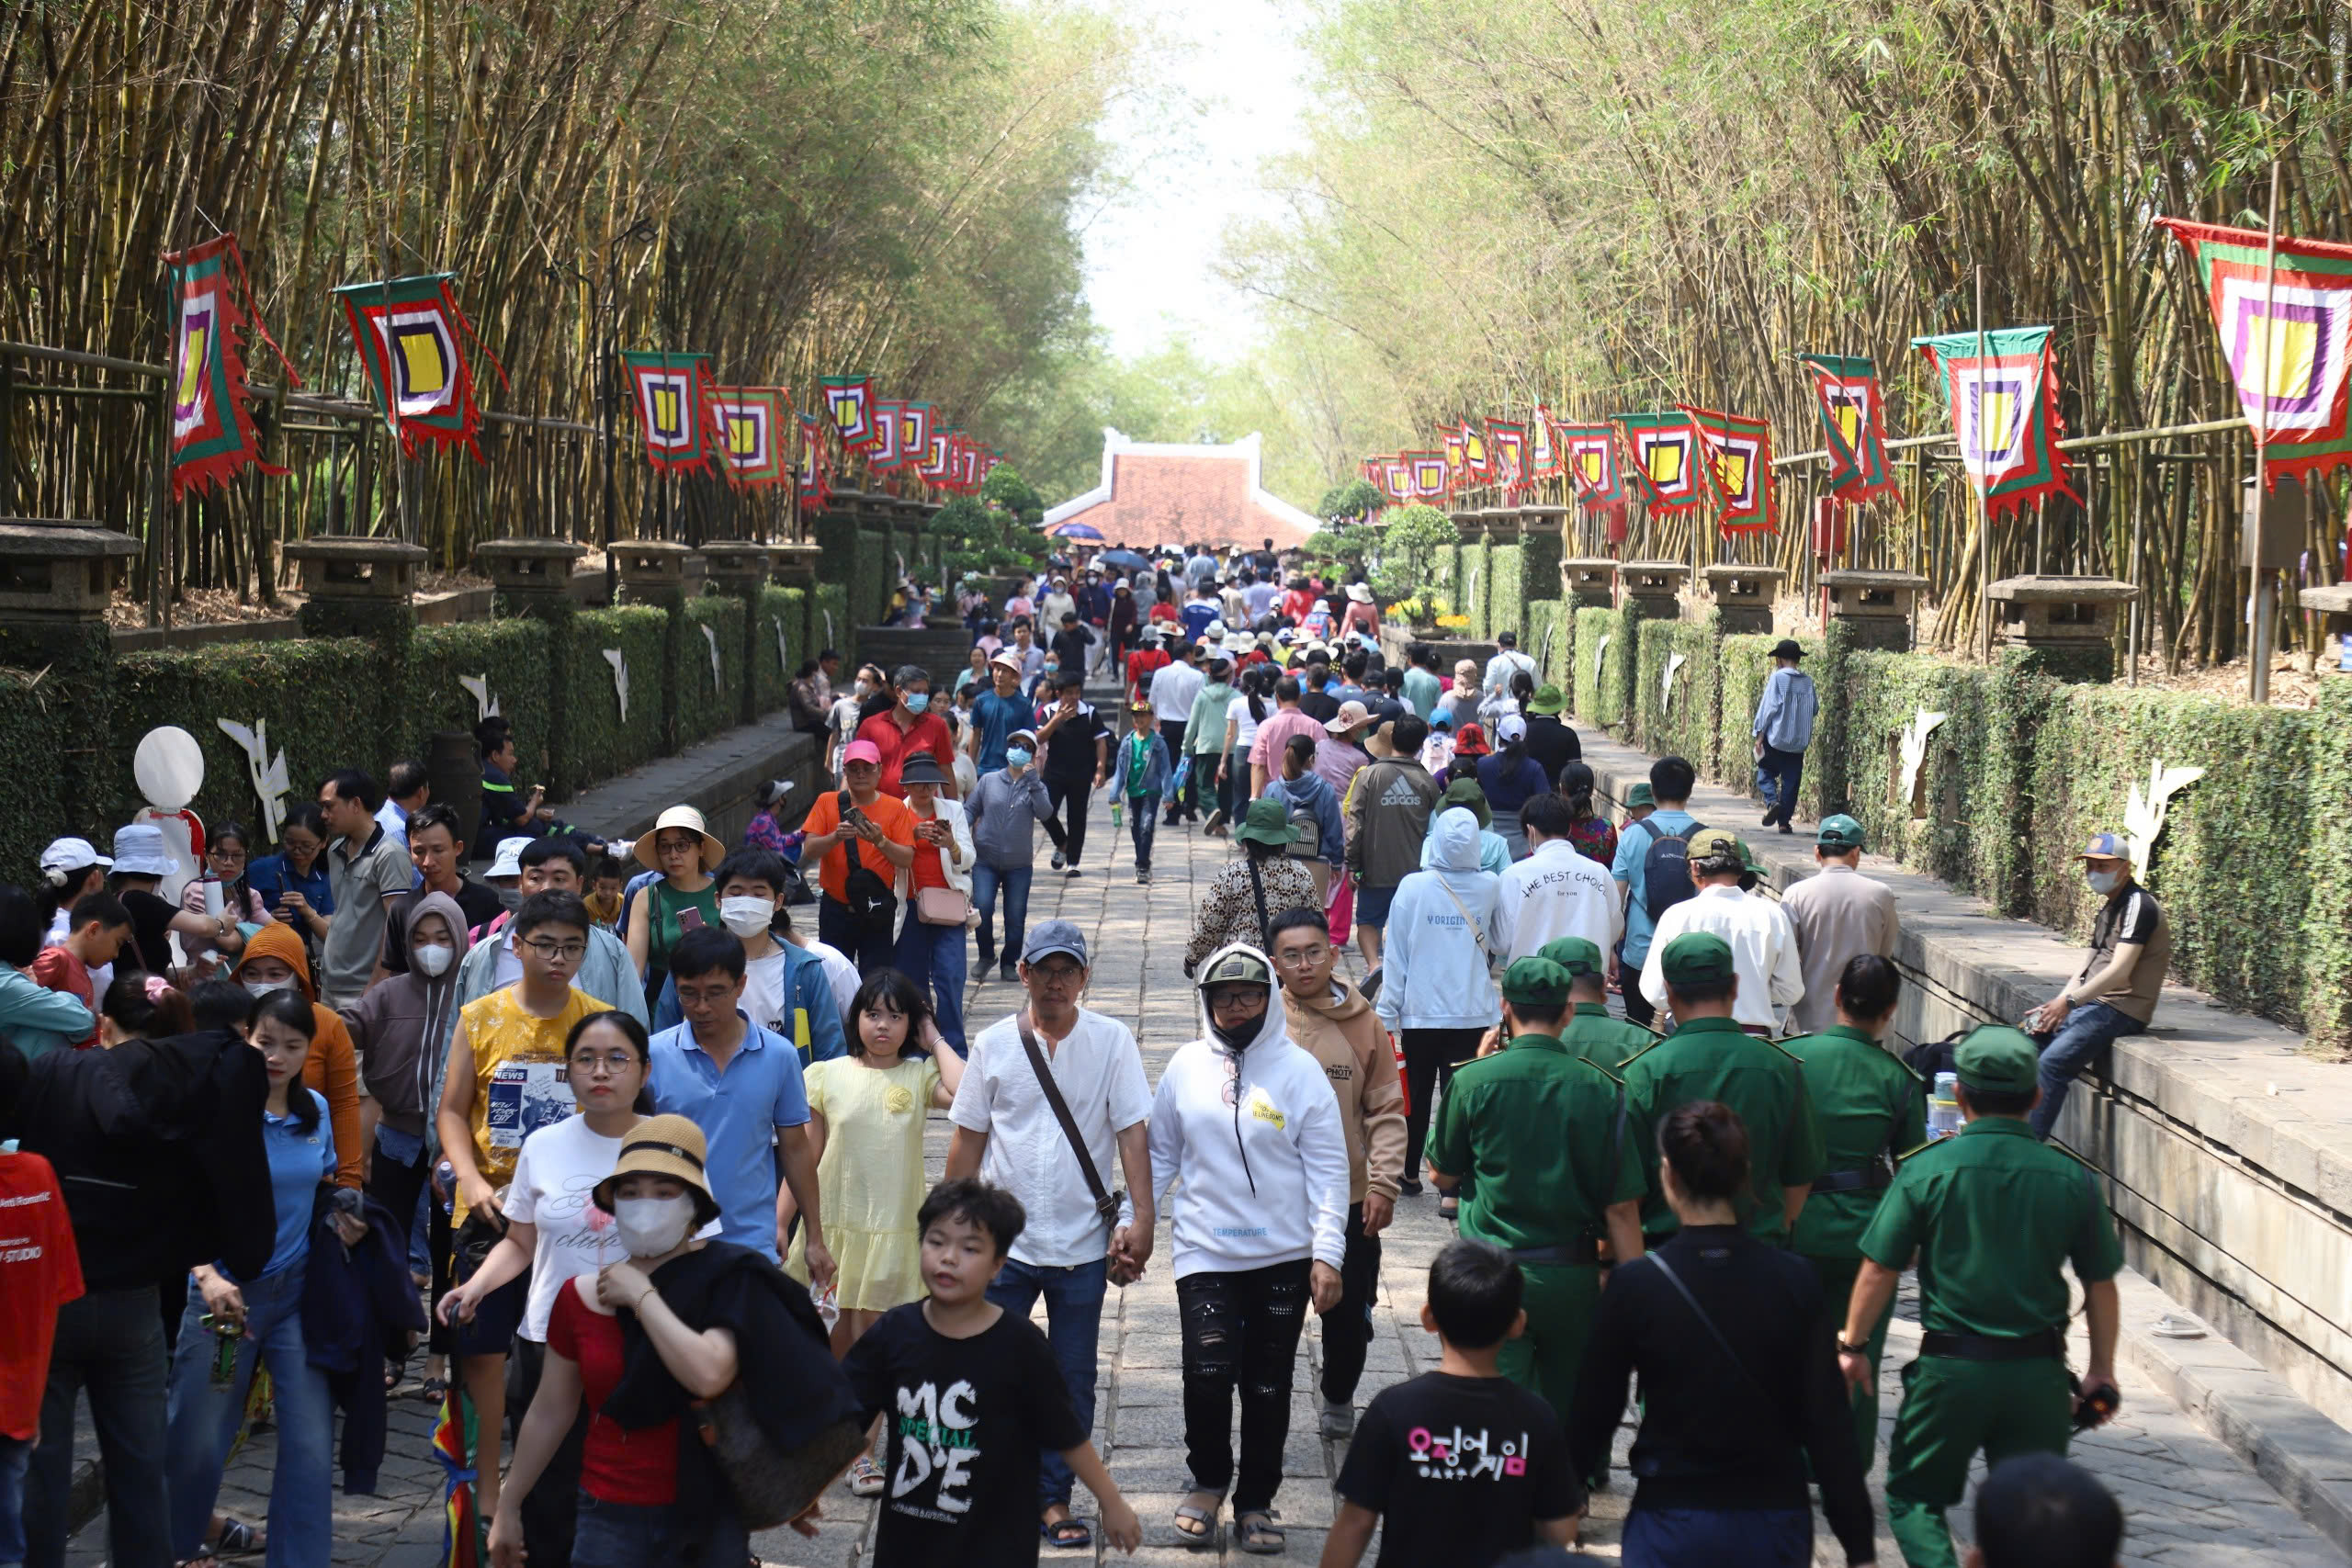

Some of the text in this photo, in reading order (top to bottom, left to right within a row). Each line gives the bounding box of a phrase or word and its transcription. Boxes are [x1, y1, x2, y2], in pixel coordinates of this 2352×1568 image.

[1381, 795, 1421, 807] adidas
[1544, 872, 1571, 884] BEST
[493, 1070, 525, 1080] NEWS
[1213, 1227, 1268, 1237] TEMPERATURE
